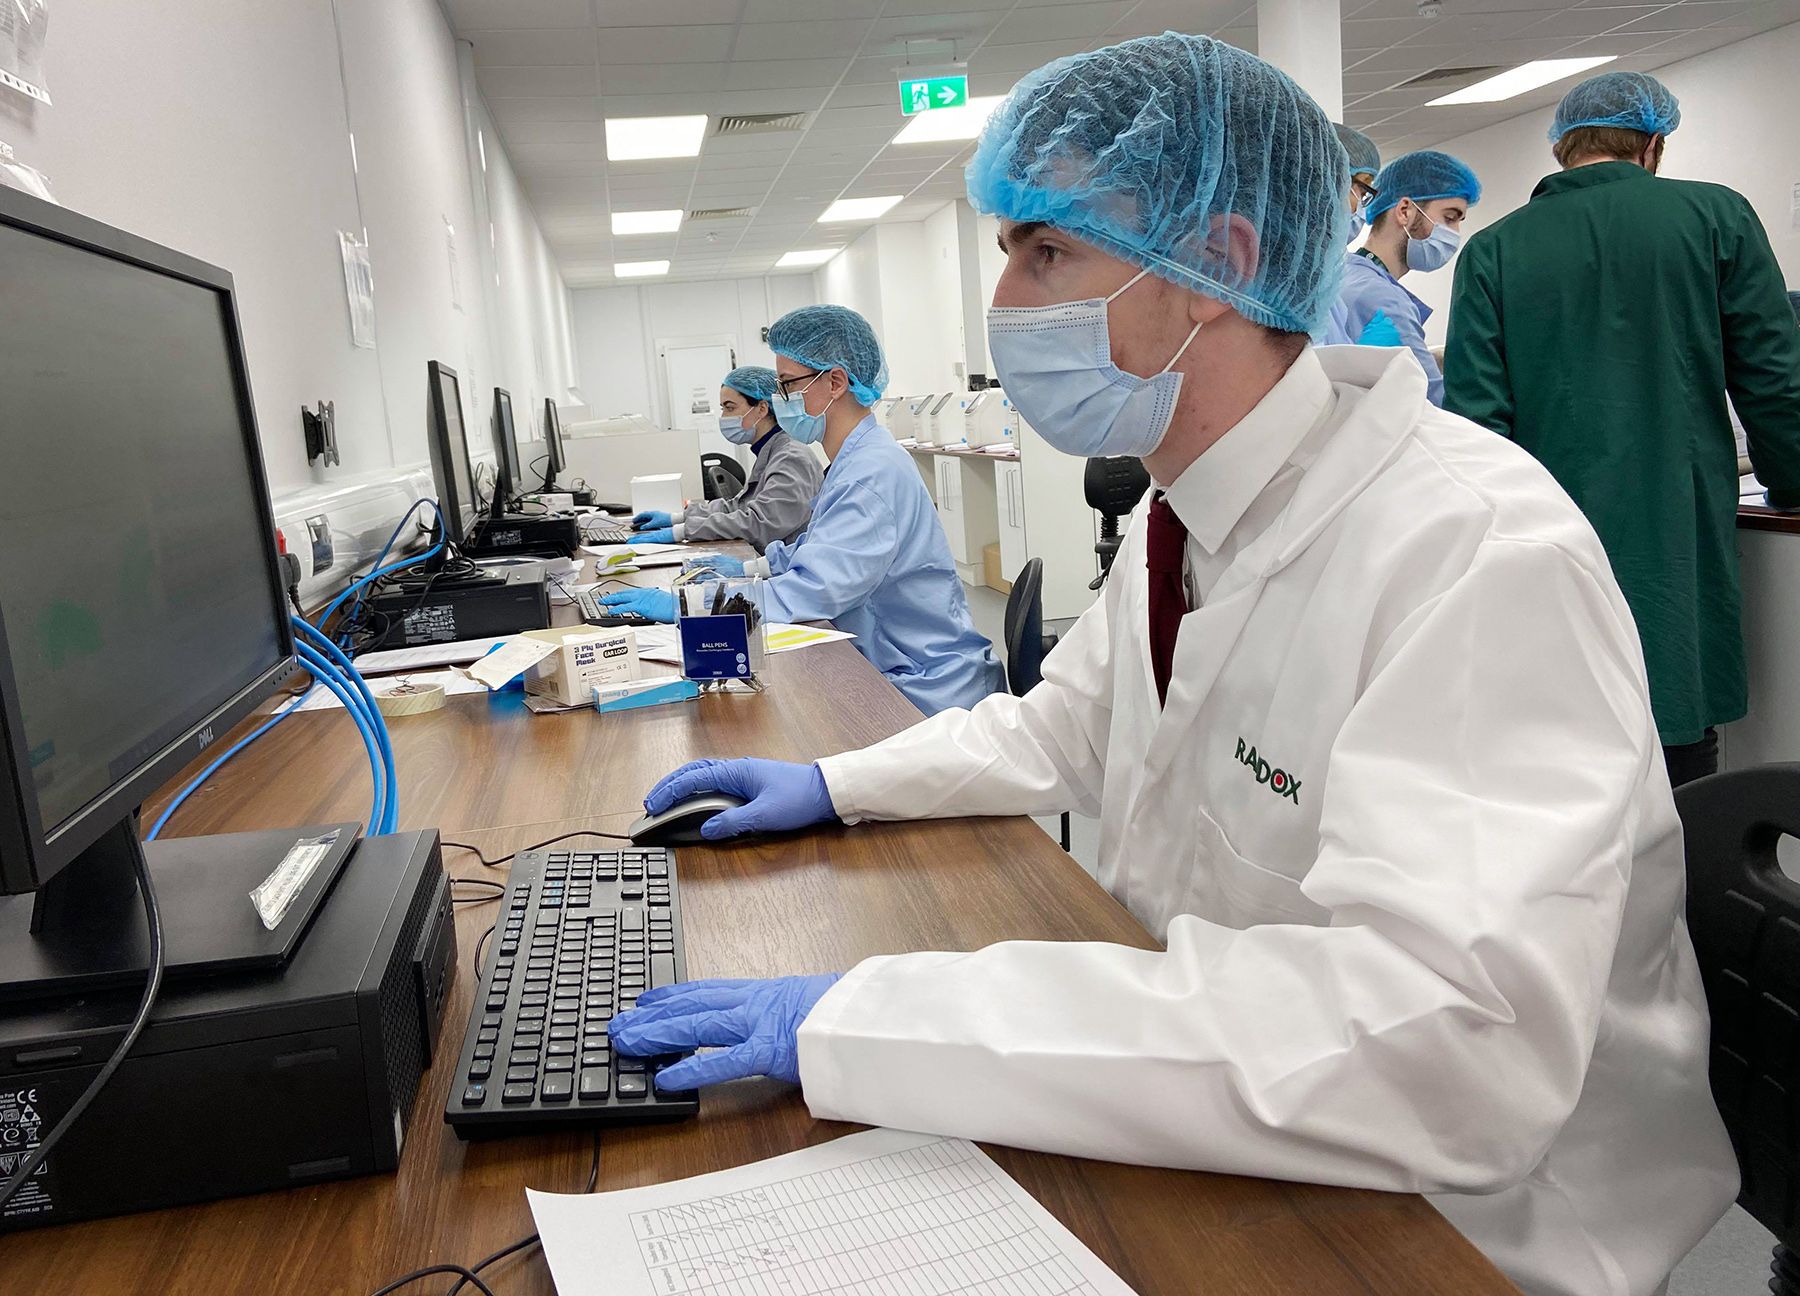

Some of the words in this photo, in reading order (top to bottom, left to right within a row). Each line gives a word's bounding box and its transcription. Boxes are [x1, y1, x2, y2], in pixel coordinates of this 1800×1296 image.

[581, 644, 594, 652] Ply
[595, 637, 626, 649] Surgical
[575, 652, 594, 660] Face
[615, 647, 628, 656] LOOP
[576, 658, 596, 666] Mask
[198, 726, 214, 750] DELL
